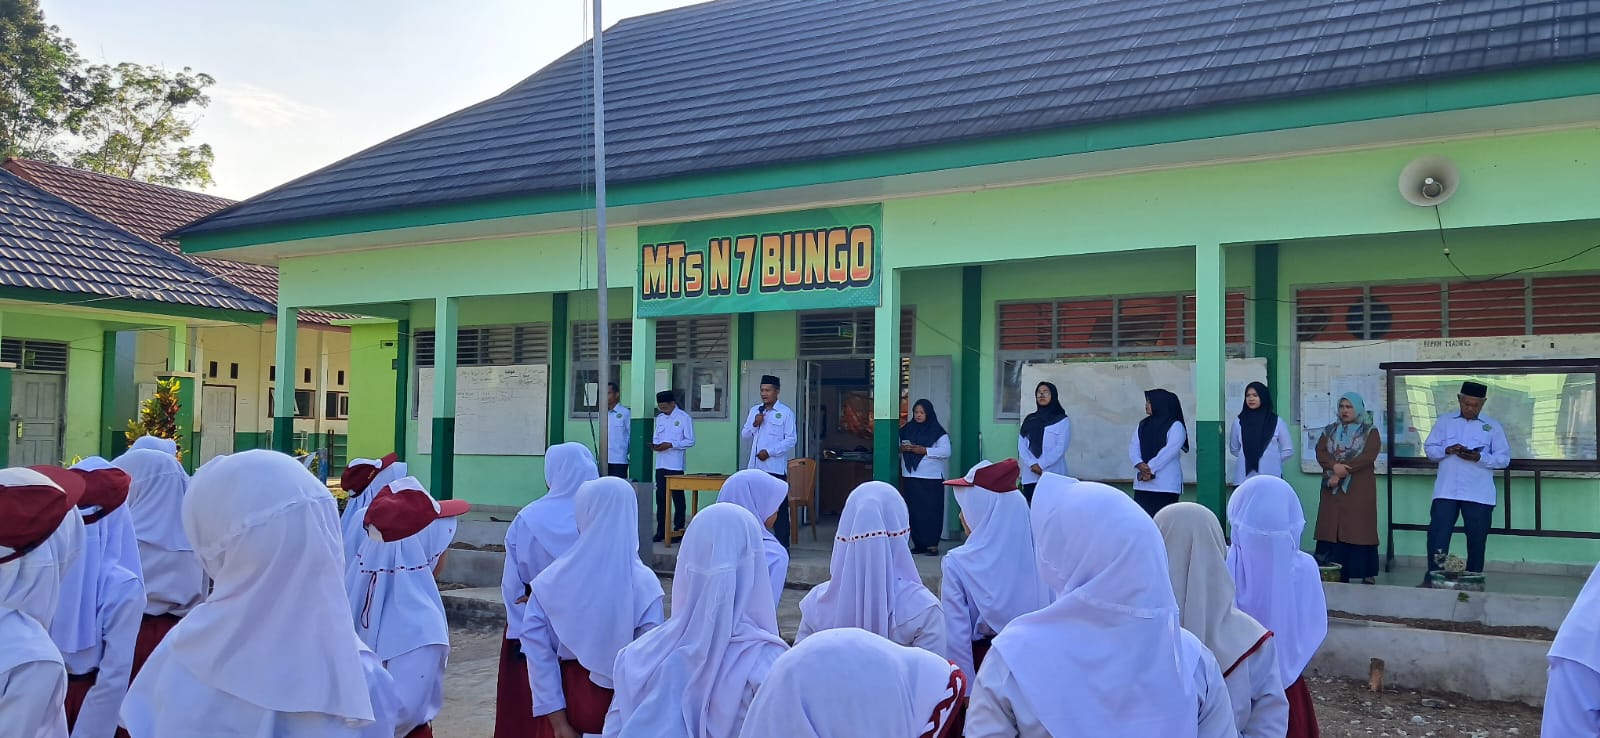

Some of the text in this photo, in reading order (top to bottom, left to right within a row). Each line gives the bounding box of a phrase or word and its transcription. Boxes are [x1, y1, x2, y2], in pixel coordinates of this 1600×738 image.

[642, 225, 874, 299] MTs N 7 BUNGO
